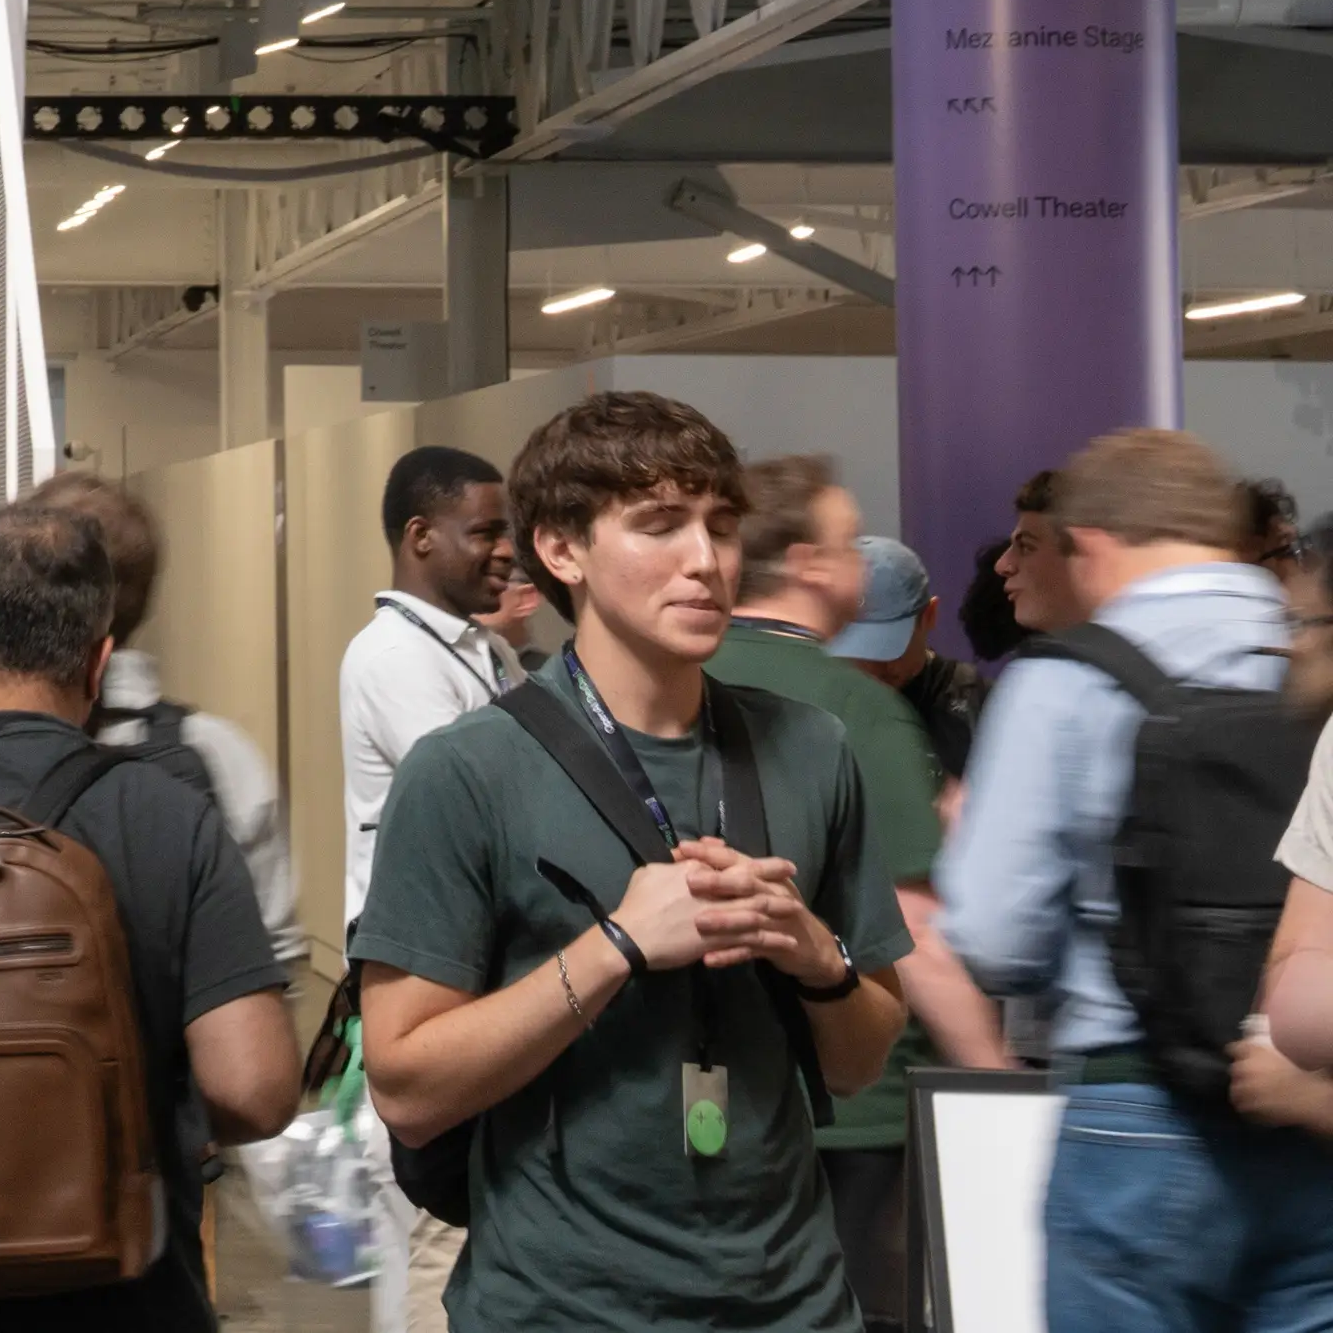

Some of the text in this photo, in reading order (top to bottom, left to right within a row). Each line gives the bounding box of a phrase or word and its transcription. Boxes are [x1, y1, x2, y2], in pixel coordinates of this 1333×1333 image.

[945, 25, 1145, 55] Mezanine Stage
[948, 195, 1129, 221] Cowell Theater
